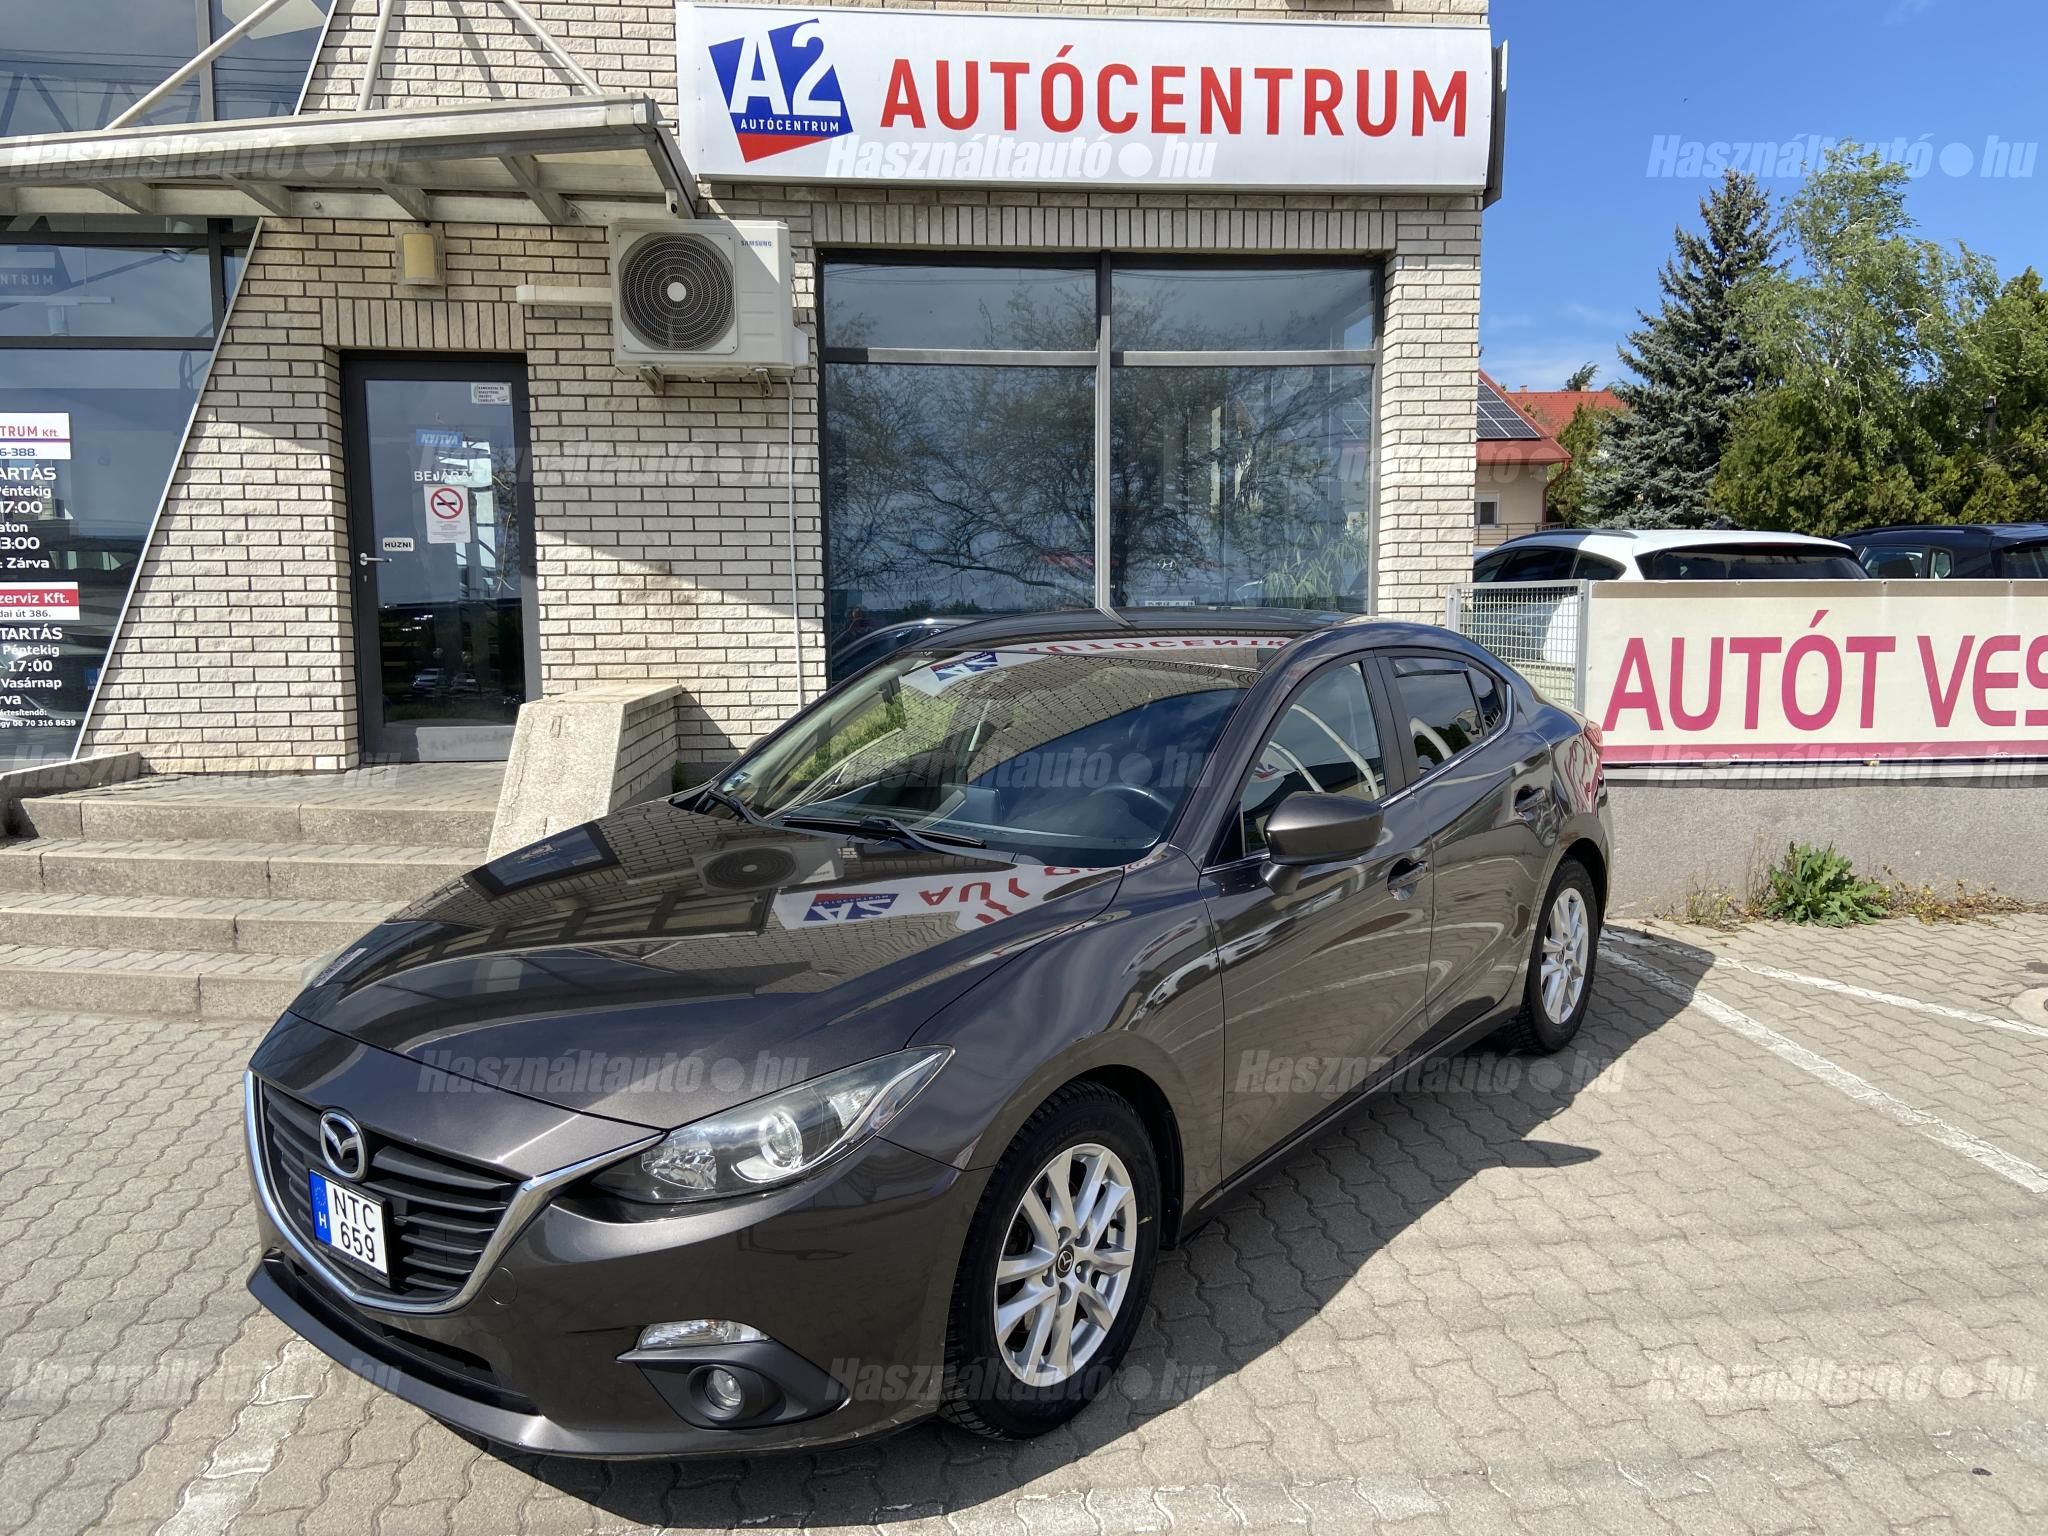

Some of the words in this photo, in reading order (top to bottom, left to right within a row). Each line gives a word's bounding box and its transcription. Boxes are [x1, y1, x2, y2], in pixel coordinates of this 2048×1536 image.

[729, 21, 841, 117] A2
[880, 45, 1467, 137] AUTÓCENTRUM
[741, 117, 839, 132] AUTÓCENTRUM
[0, 485, 52, 499] éntekig
[6, 557, 50, 569] Zárva
[44, 593, 70, 604] Kft.
[16, 609, 26, 618] út
[2, 644, 60, 657] Péntekig
[8, 659, 53, 672] 17:00
[1601, 609, 1896, 731] AUTÓT
[1, 677, 62, 690] Vasárnap
[333, 1187, 376, 1232] NTC
[318, 1211, 327, 1229] H
[340, 1221, 375, 1263] 659
